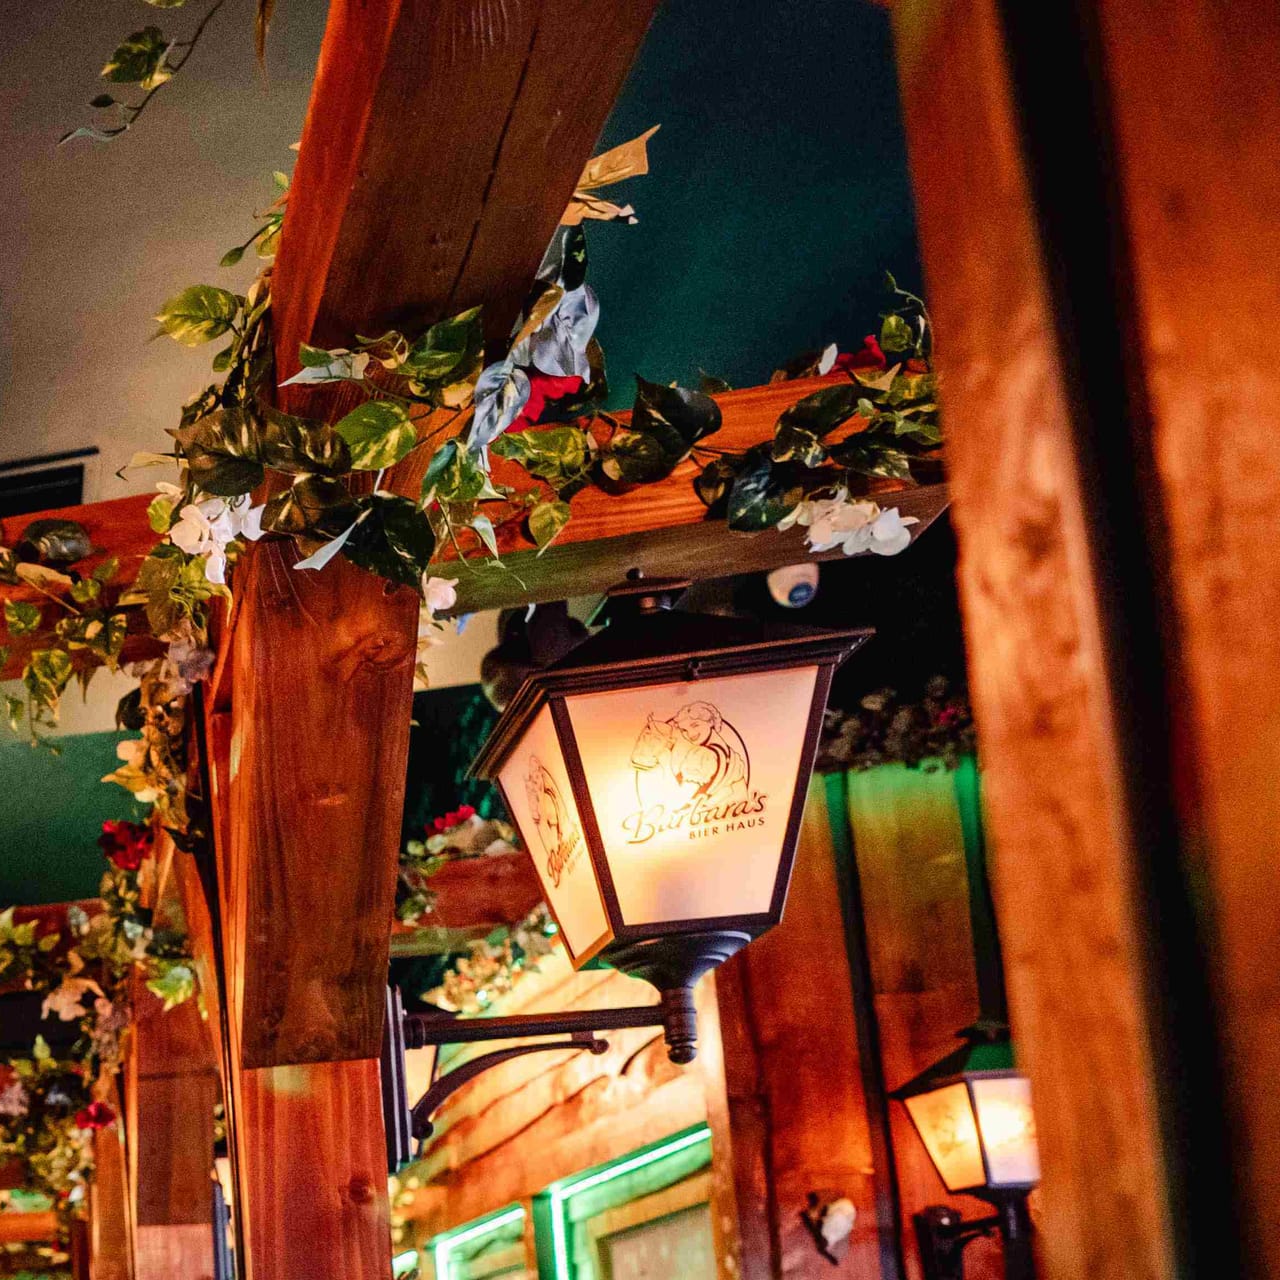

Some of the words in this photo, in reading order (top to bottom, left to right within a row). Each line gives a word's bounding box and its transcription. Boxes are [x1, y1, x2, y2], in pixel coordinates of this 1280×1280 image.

[622, 791, 768, 845] Barbara's
[689, 826, 720, 840] BIER
[726, 816, 766, 833] HAUS
